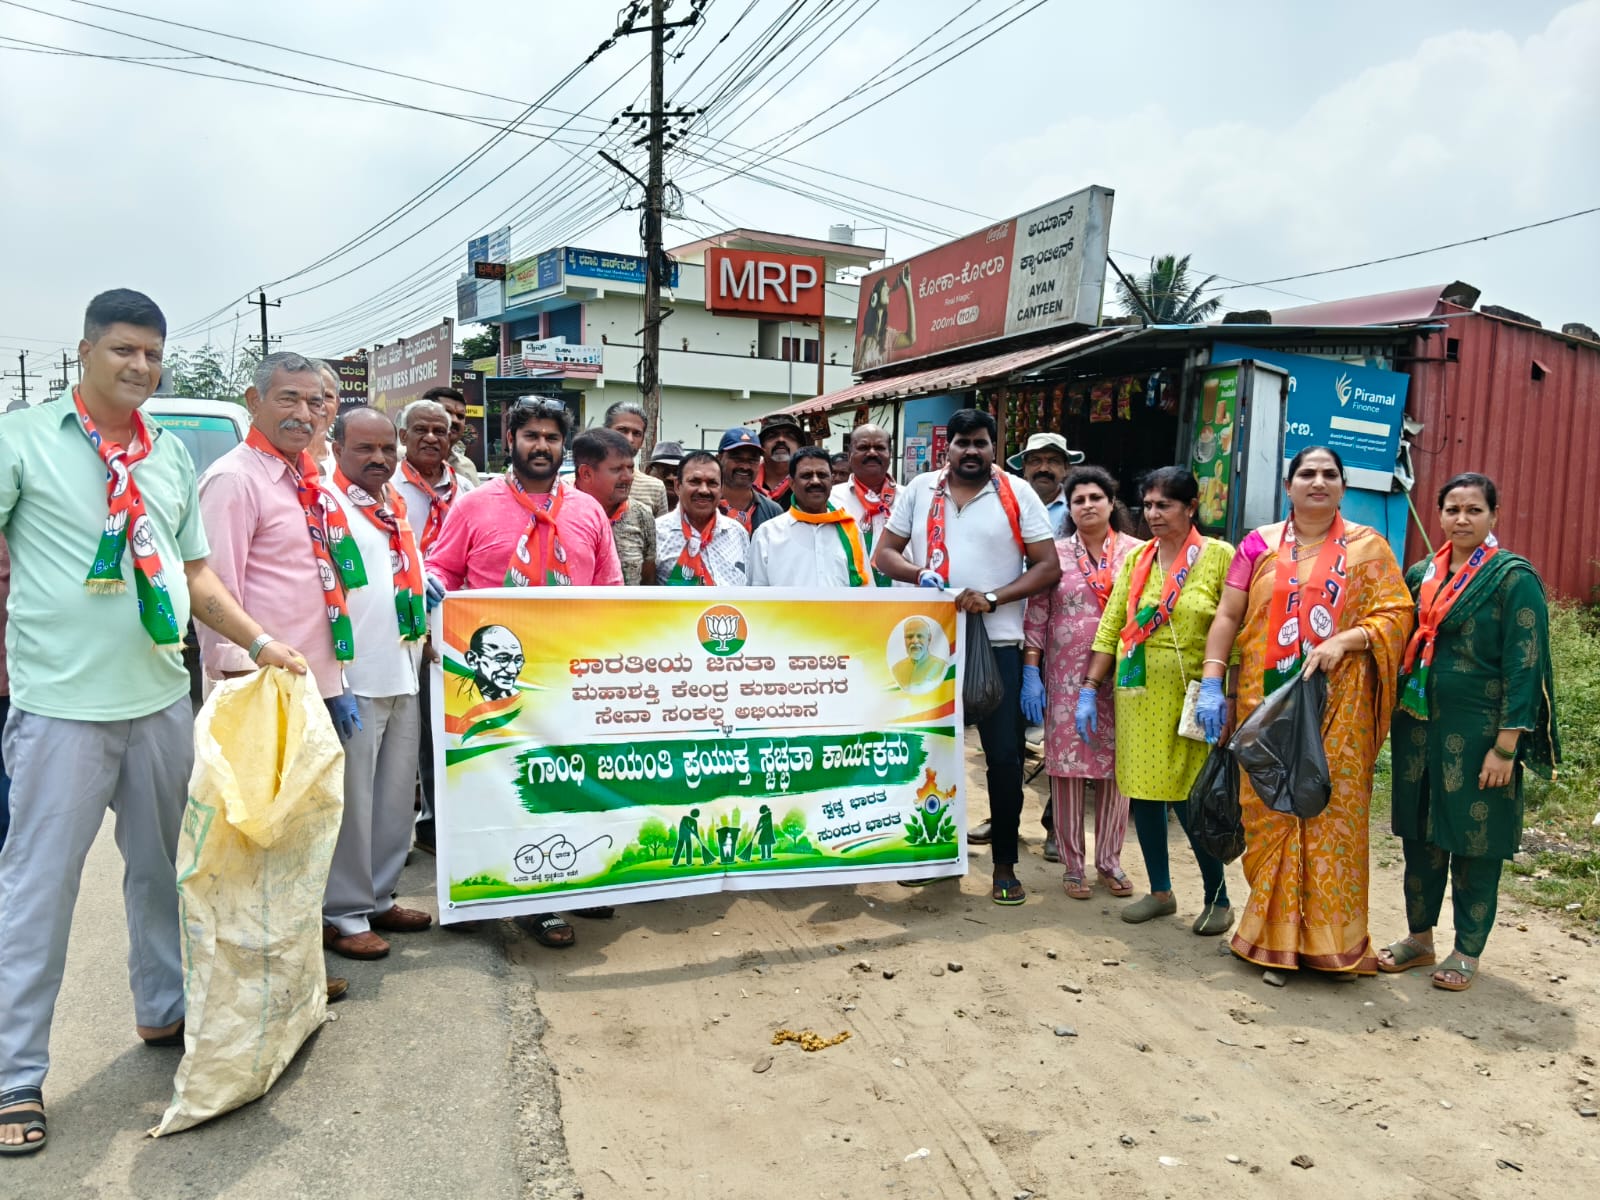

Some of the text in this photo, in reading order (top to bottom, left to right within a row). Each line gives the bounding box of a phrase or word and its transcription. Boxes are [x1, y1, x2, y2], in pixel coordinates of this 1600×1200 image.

[720, 256, 818, 304] MRP
[918, 255, 1005, 298] ಕೋಕಾ-ಕೋಲಾ
[1028, 279, 1056, 298] AYAN
[930, 314, 956, 332] 200ml
[1016, 299, 1063, 322] CANTEEN
[376, 374, 393, 393] RUCHI
[392, 369, 409, 389] MESS
[409, 359, 438, 385] MYSORE
[1352, 402, 1380, 413] Finance
[1354, 387, 1396, 406] Piramal
[568, 651, 851, 678] ಭಾರತೀಯ ಜನತಾ ಪಾರ್ಟಿ
[572, 678, 849, 705] ಮಹಾಶಕ್ತಿ ಕೇಂದ್ರ ಕುಶಾಲನಗರ
[595, 706, 651, 725] ಸೇವಾ
[734, 701, 819, 722] ಅಭಿಯಾನ
[527, 753, 586, 786] ಗಾಂಧಿ
[597, 745, 674, 780] ಜಯಂತಿ
[682, 740, 752, 789] ಪ್ರಯುಕ್ತ
[821, 734, 910, 777] ಕಾರ್ಯಕ್ರಮ
[849, 789, 887, 809] ಭಾರತ
[817, 812, 902, 841] ಸುಂದರ ಭಾರತ
